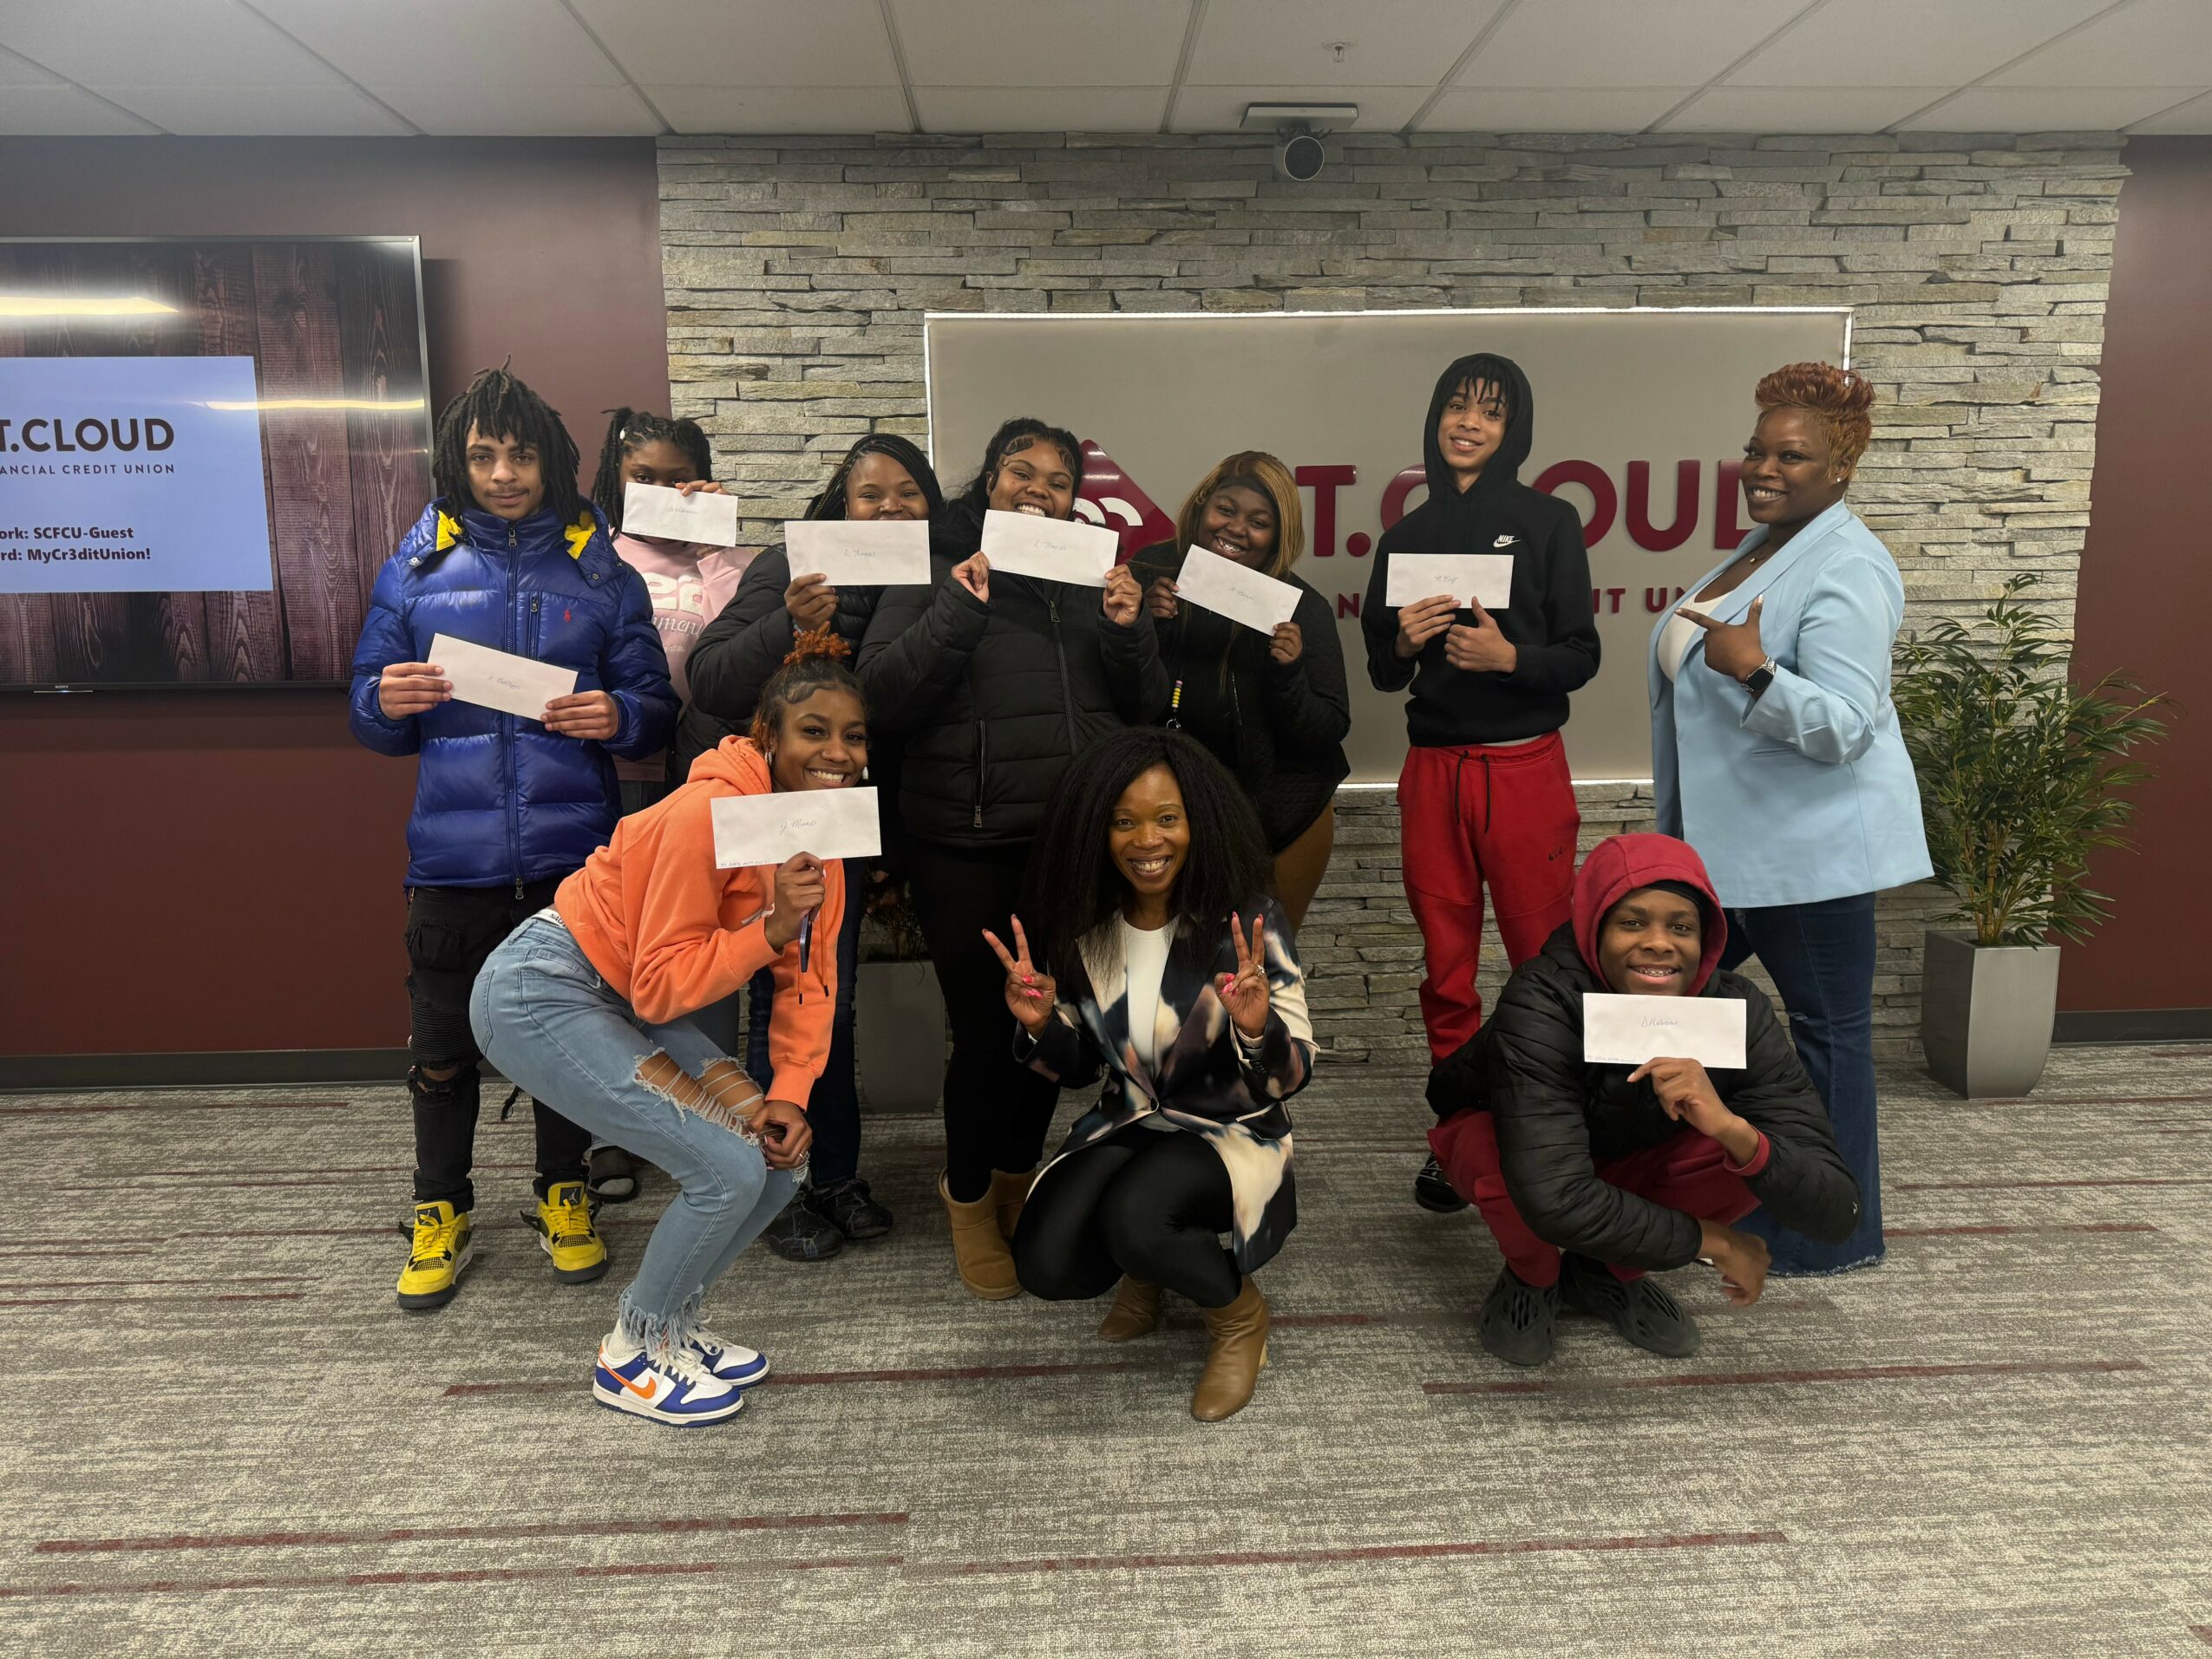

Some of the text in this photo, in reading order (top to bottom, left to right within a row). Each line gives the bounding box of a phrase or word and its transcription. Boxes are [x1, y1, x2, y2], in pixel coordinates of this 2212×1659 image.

[62, 465, 117, 474] CREDIT
[124, 464, 174, 474] UNION
[33, 526, 134, 539] SCFCU-Guest
[1497, 534, 1515, 544] NIKE
[27, 548, 151, 564] MyCr3ditUnion!
